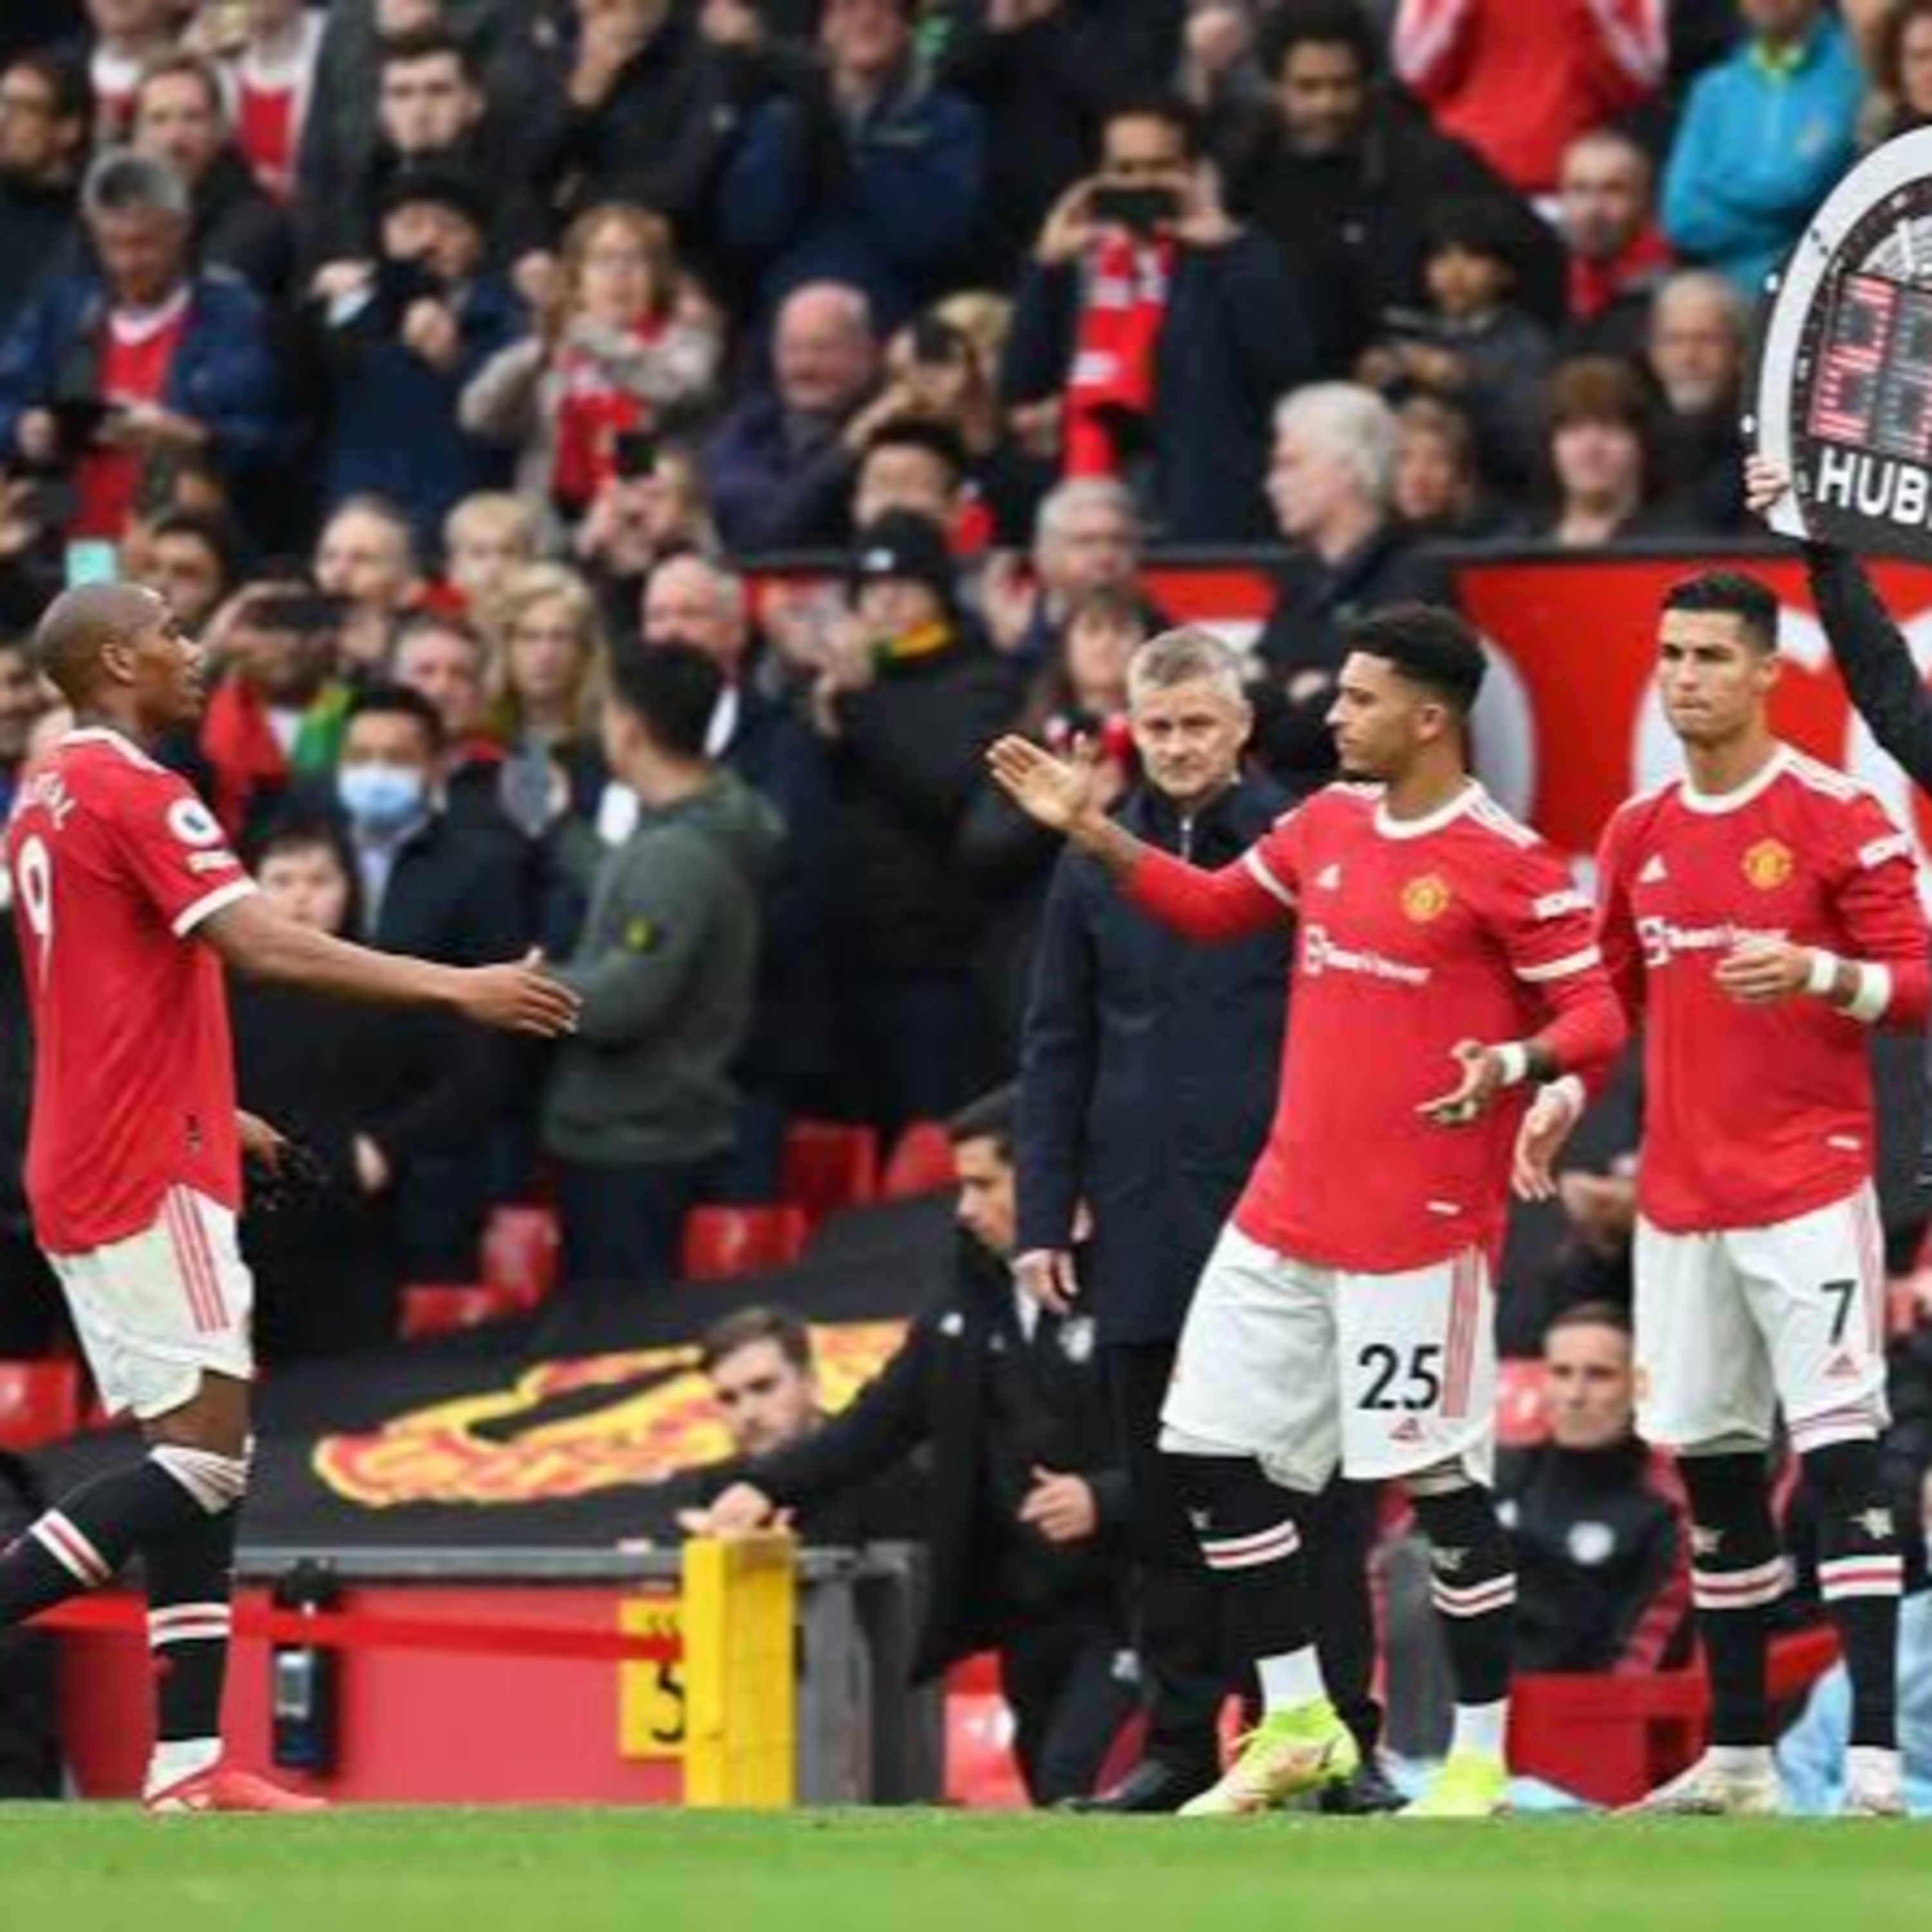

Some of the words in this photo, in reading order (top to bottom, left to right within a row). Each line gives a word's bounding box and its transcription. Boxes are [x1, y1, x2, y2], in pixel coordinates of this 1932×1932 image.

[1816, 446, 1932, 531] HUB
[17, 833, 54, 989] 9
[1819, 1279, 1857, 1347] 7
[1356, 1343, 1441, 1410] 25
